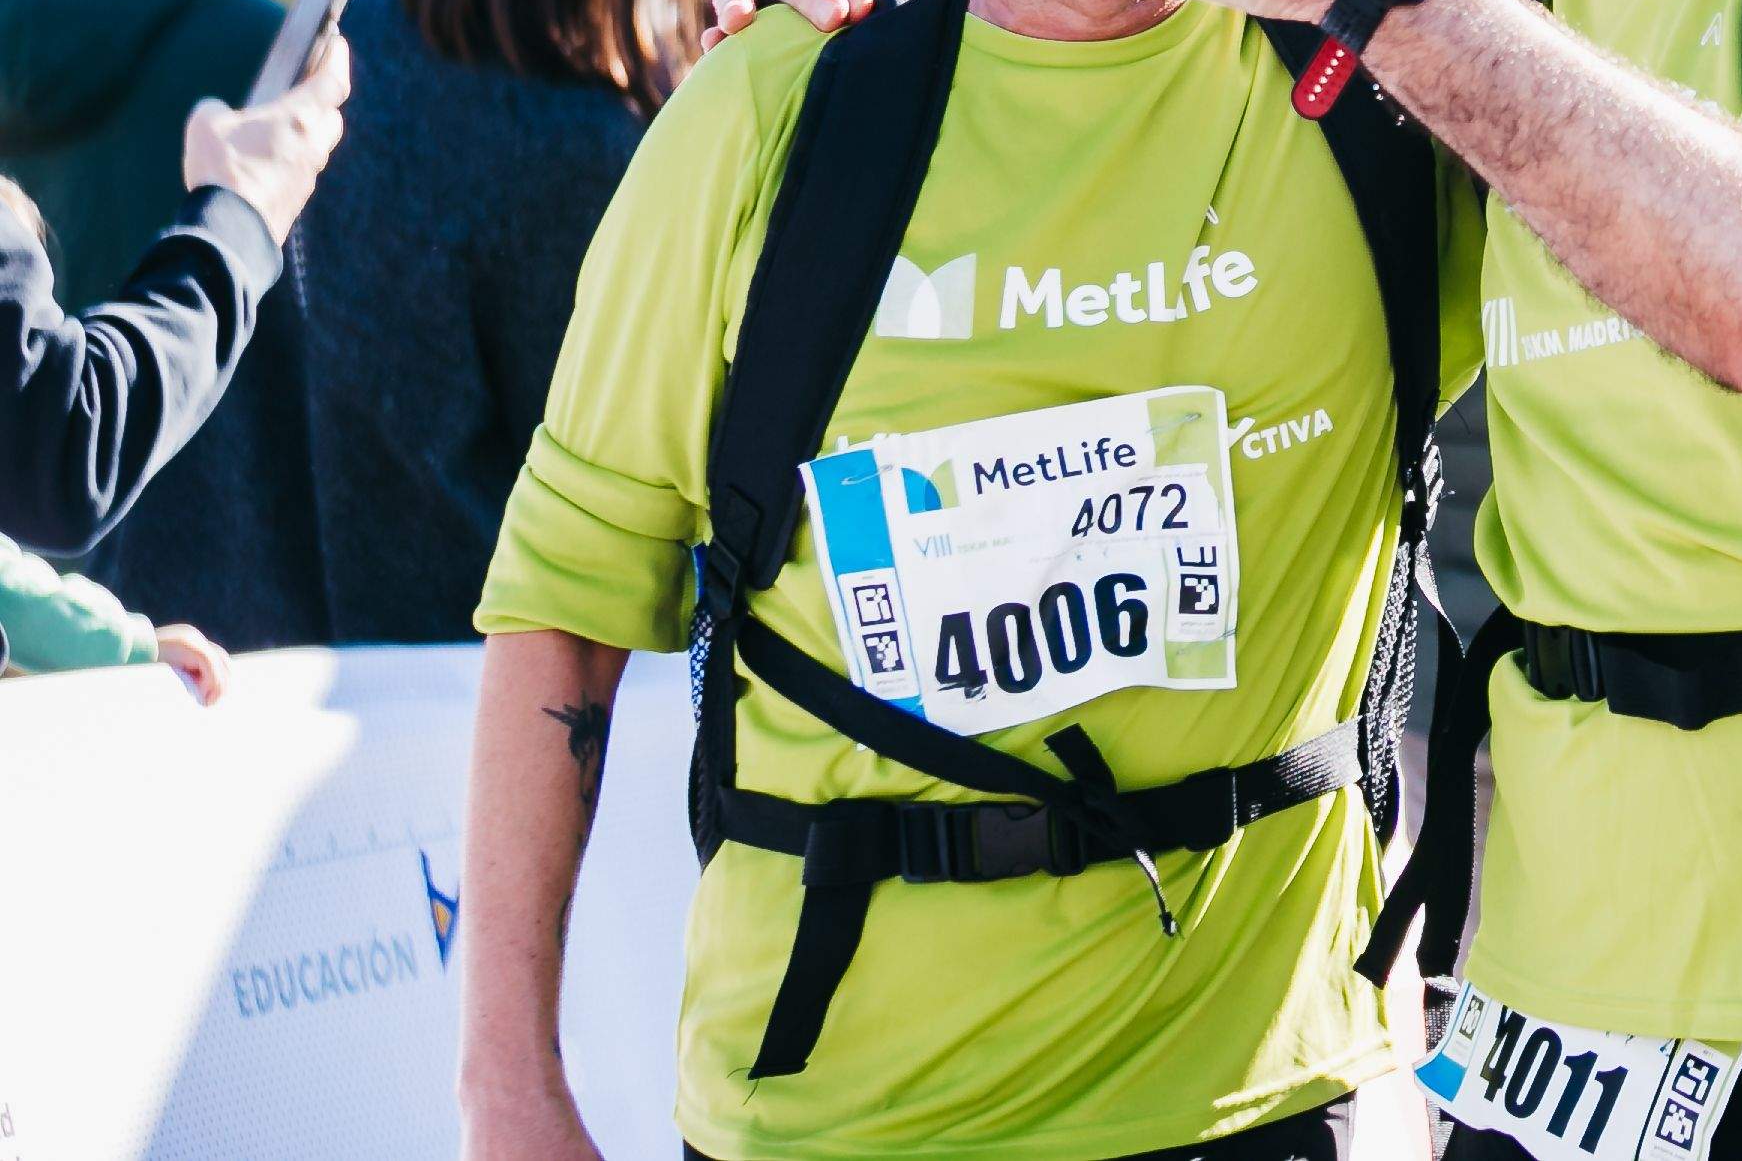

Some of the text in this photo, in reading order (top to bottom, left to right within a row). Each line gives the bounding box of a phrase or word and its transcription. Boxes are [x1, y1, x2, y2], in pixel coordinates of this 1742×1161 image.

[1567, 316, 1646, 353] MADRI
[973, 437, 1137, 495] MetLife
[1071, 483, 1190, 538] 4072
[935, 573, 1149, 700] 4006
[1480, 1004, 1629, 1155] 4011
